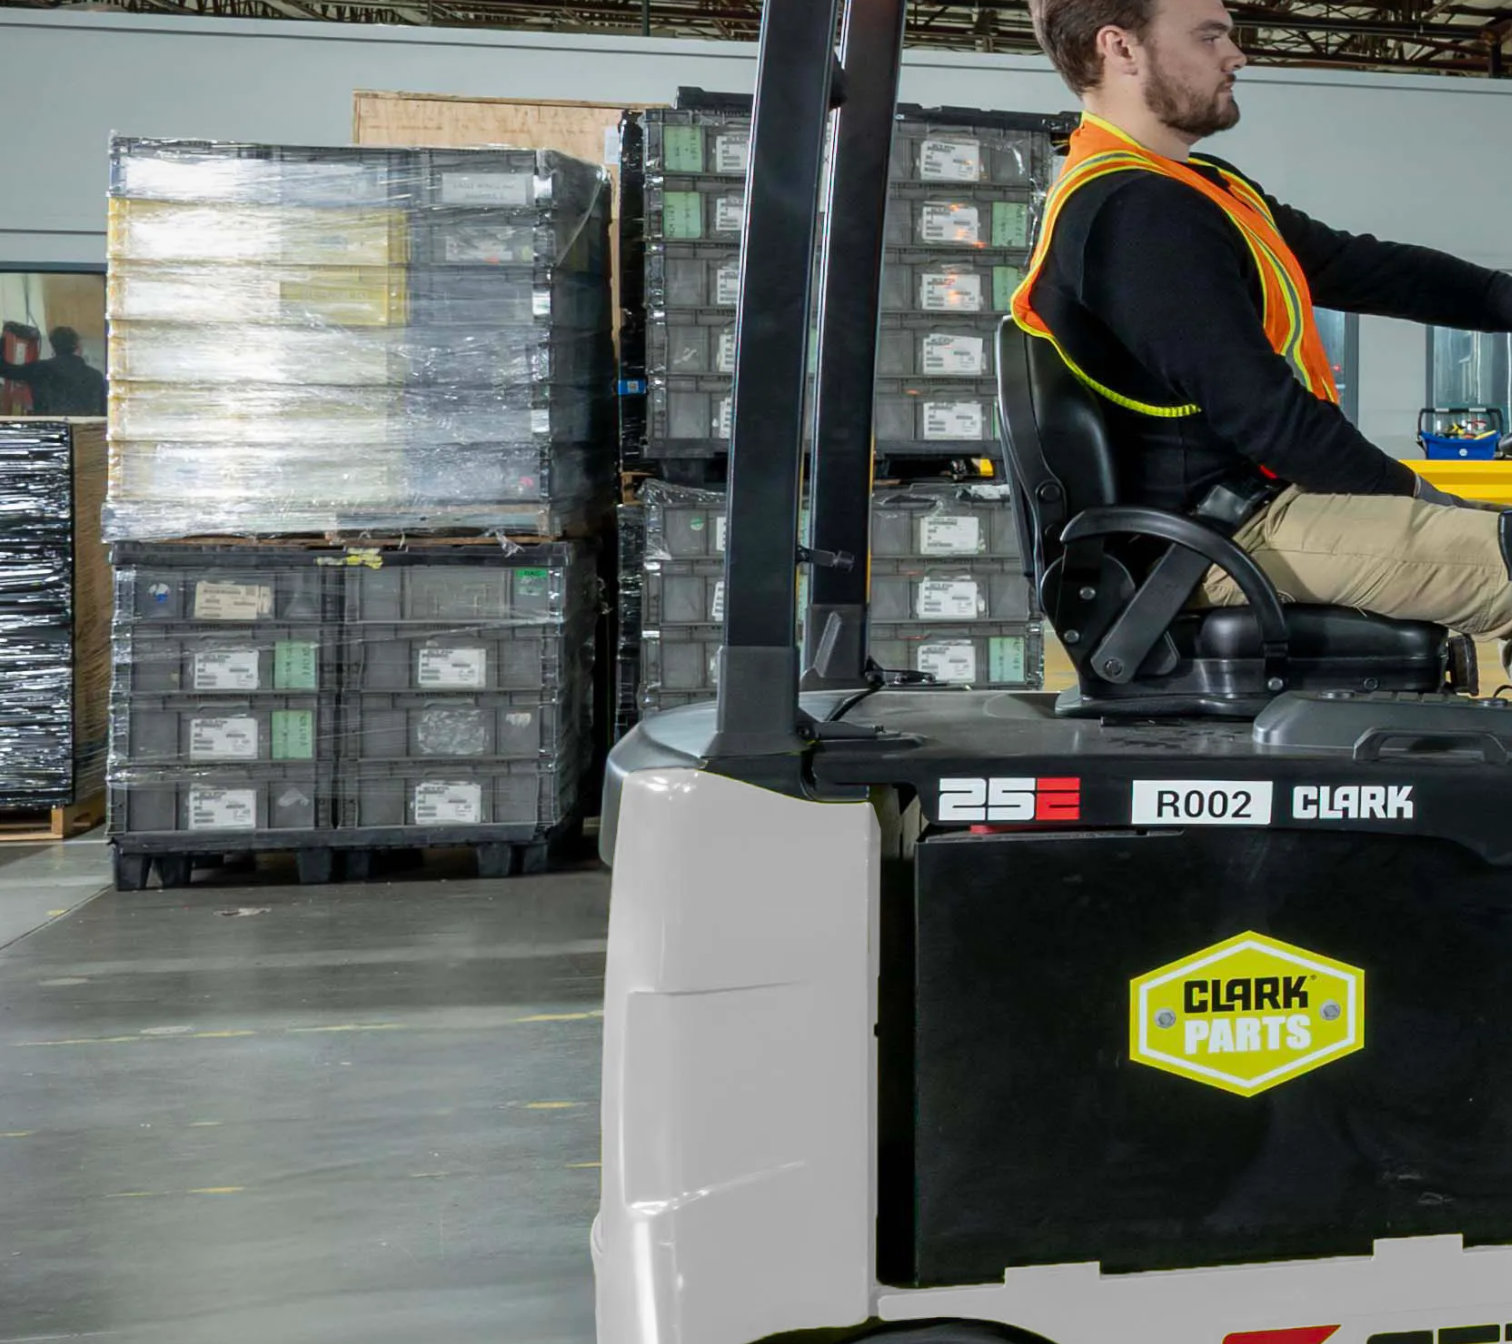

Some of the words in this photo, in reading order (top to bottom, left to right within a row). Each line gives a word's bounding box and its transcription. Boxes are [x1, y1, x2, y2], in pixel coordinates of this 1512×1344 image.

[1156, 790, 1252, 819] R002
[1292, 785, 1414, 820] CLARK
[1183, 976, 1310, 1013] CLARK
[1184, 1014, 1312, 1055] PARTS
